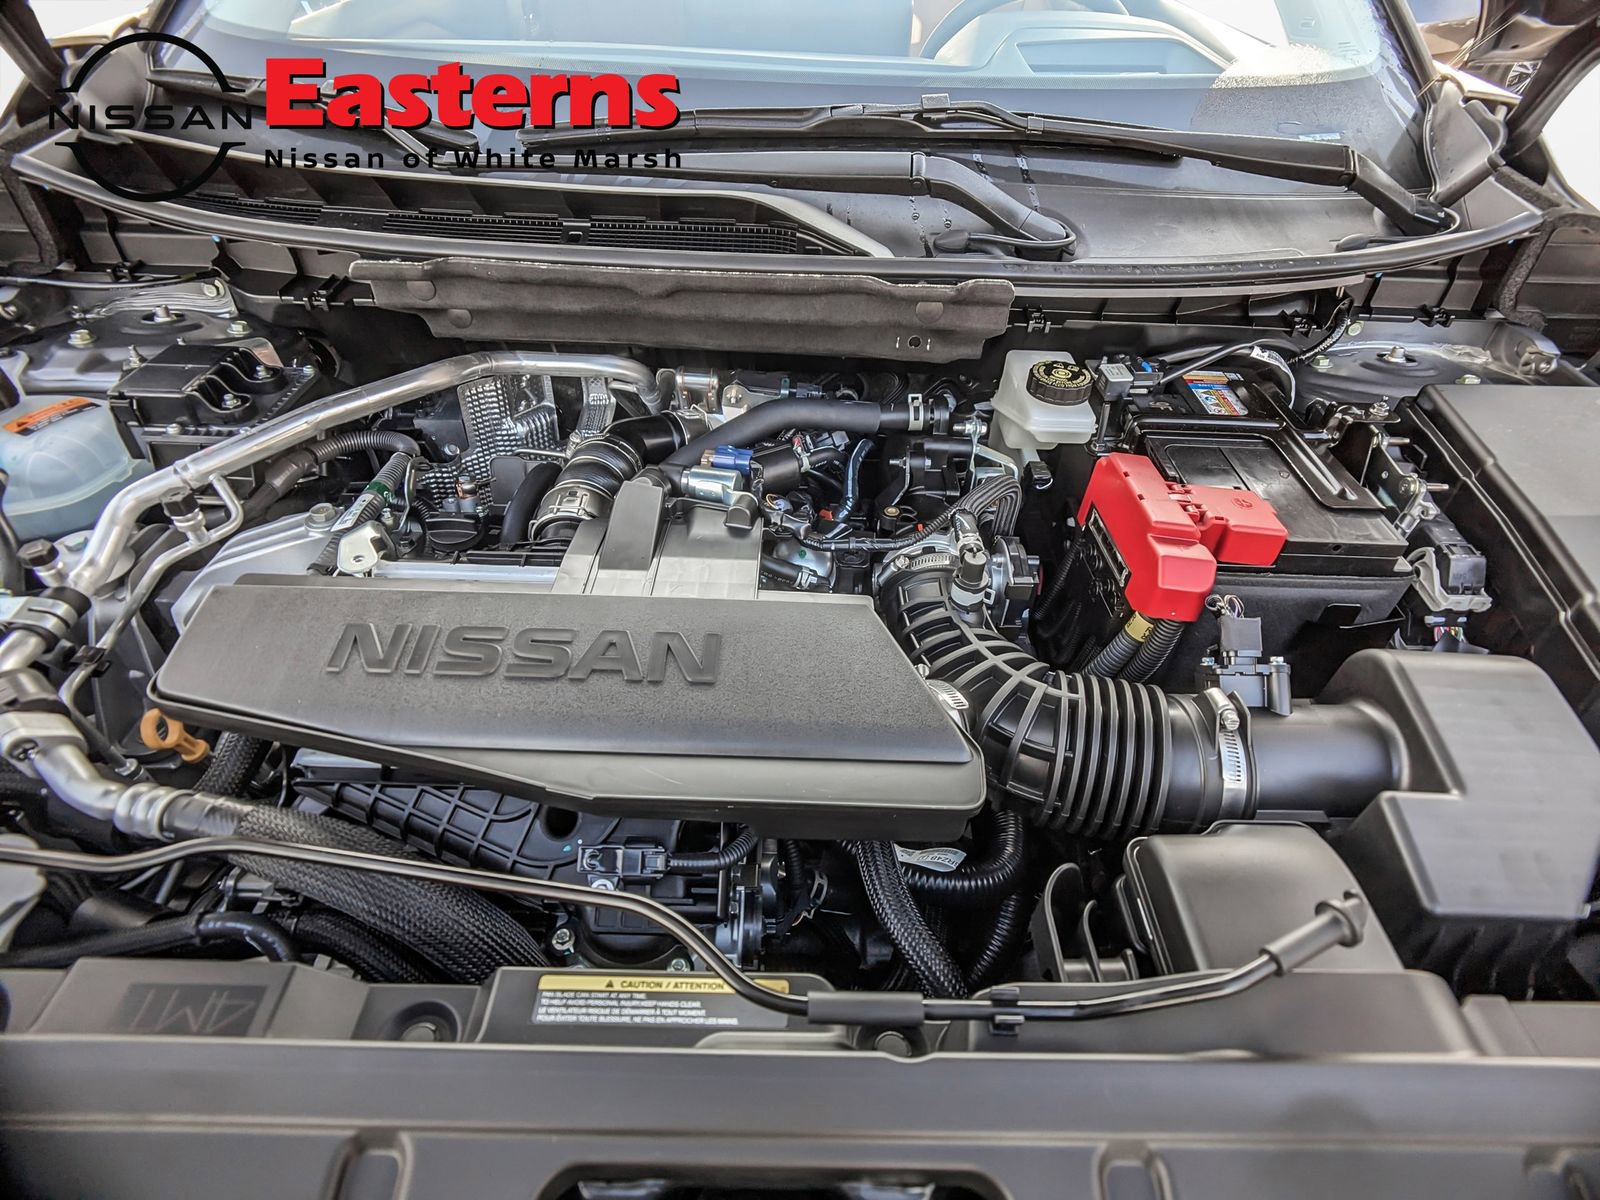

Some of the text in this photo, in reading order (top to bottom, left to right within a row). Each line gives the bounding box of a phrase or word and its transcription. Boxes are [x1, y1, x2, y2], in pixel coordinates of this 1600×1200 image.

[325, 622, 722, 685] NISSAN
[620, 980, 662, 988] CAUTION
[673, 982, 724, 990] ATTENTION
